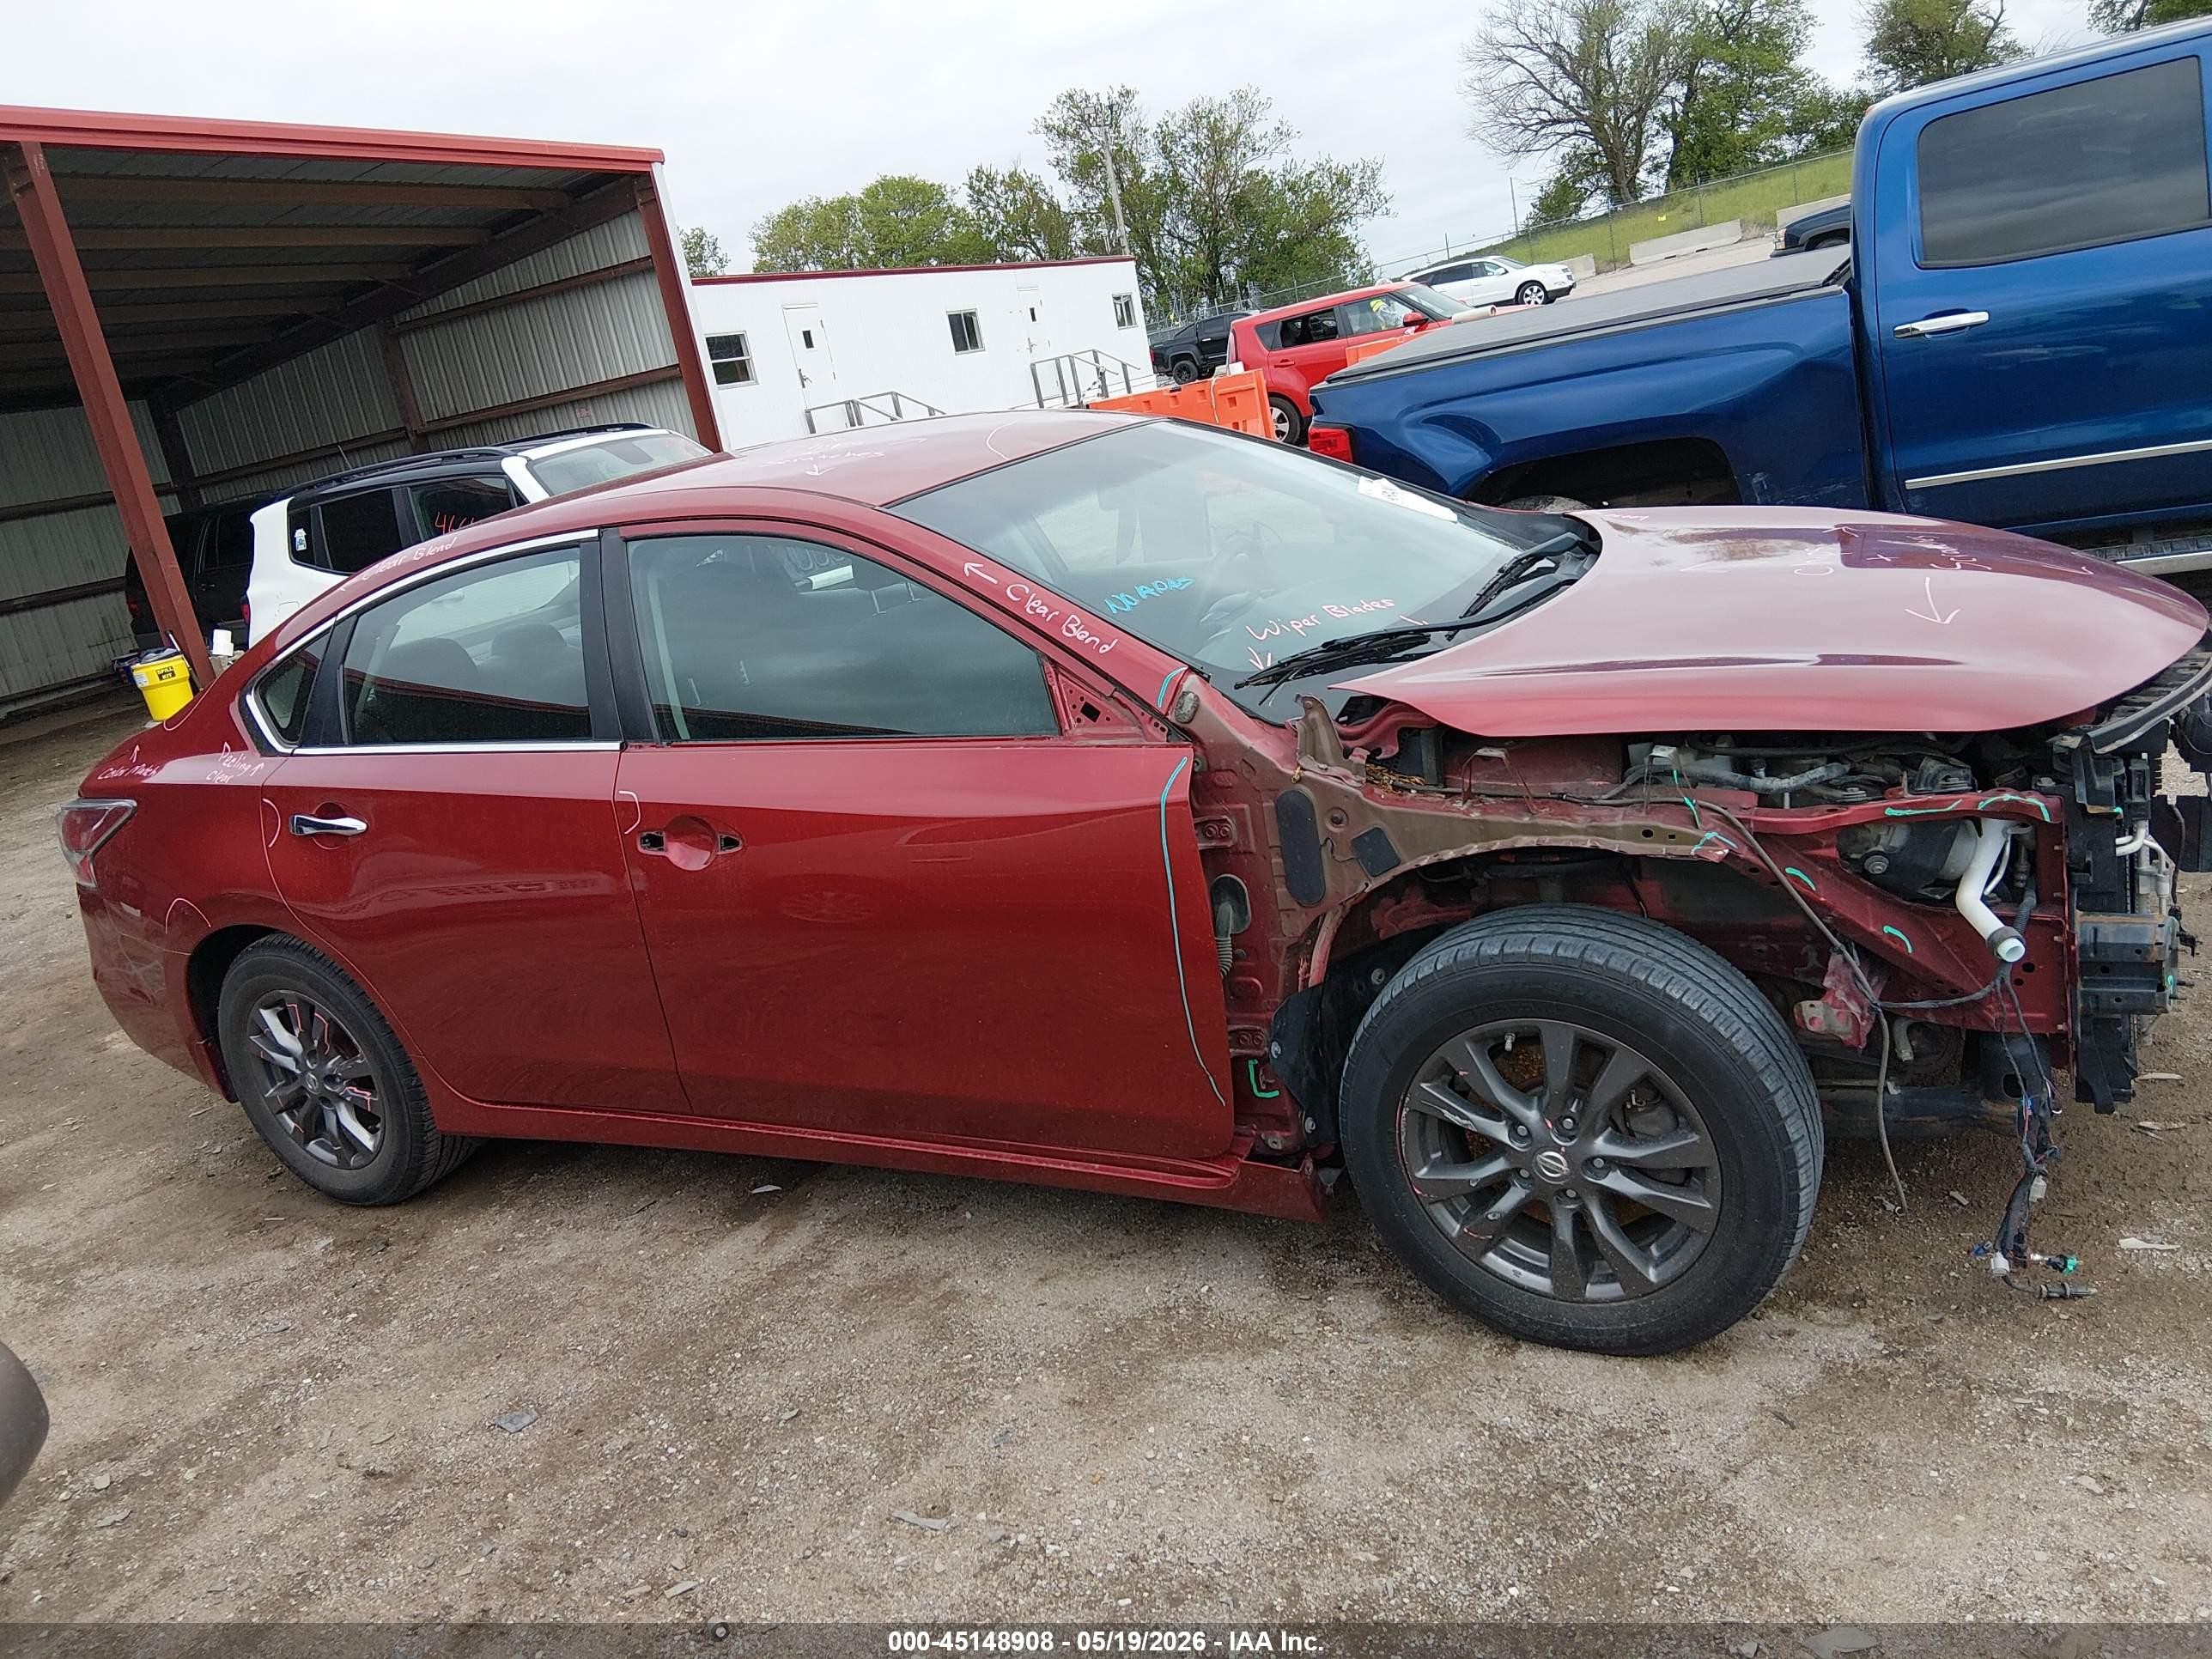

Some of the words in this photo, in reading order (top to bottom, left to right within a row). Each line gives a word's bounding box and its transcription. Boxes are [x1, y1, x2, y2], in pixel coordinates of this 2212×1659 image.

[413, 537, 458, 561] Blend
[1104, 592, 1139, 614] NO
[1006, 584, 1060, 623] Clear
[1060, 614, 1118, 654] Blend
[1245, 614, 1322, 641] Wiper
[1322, 598, 1396, 619] Blades
[157, 666, 173, 675] SPILL
[218, 741, 252, 777] Peeling
